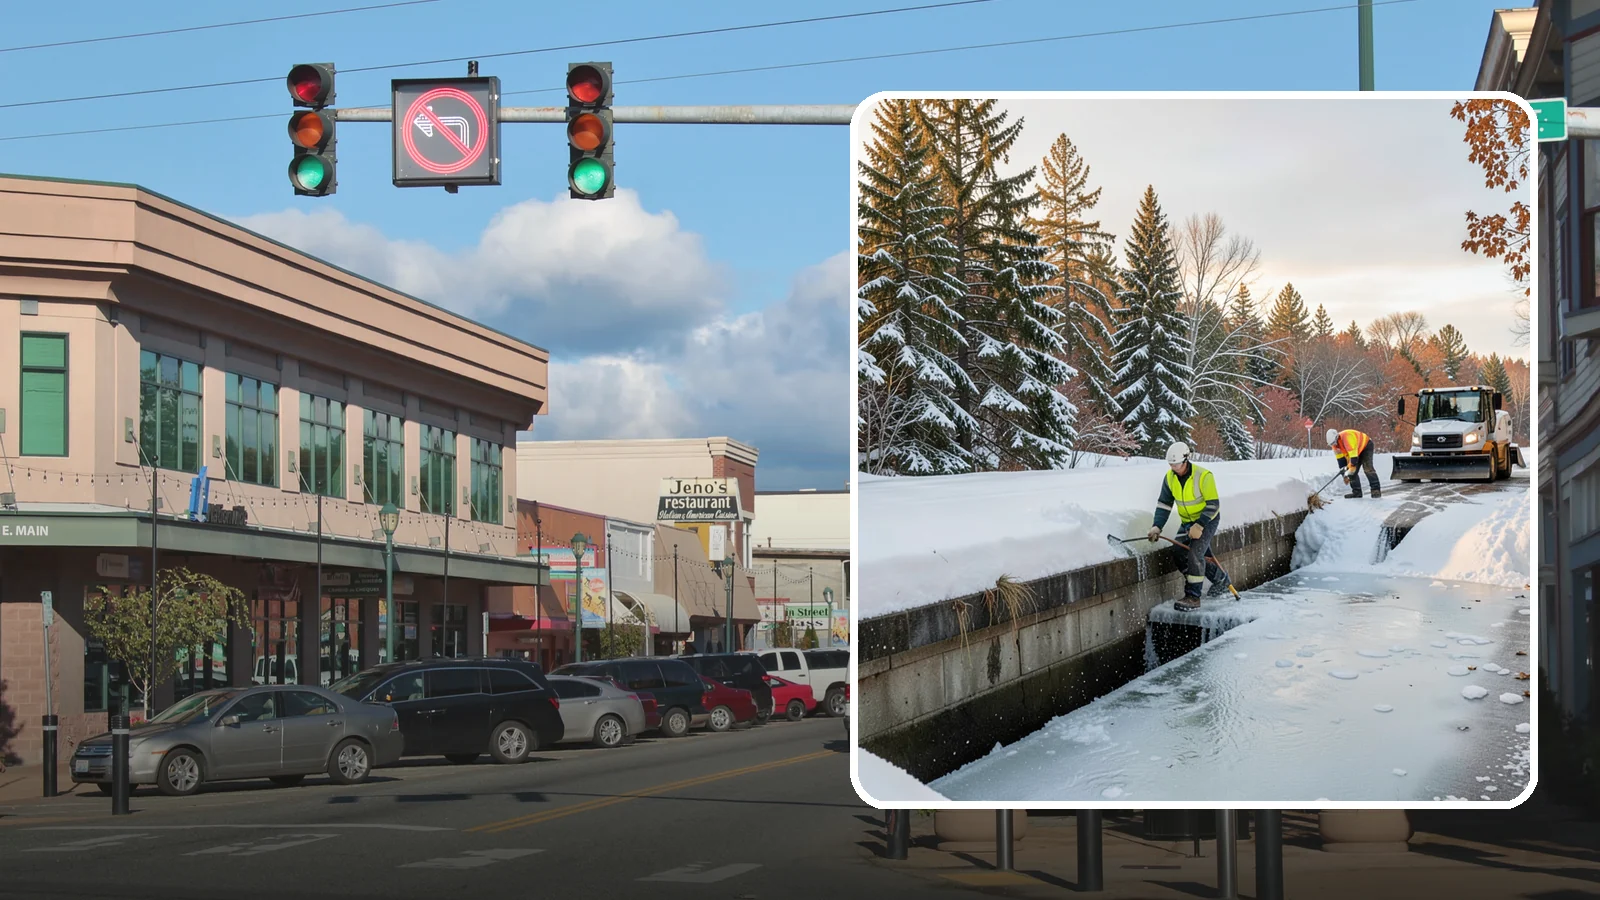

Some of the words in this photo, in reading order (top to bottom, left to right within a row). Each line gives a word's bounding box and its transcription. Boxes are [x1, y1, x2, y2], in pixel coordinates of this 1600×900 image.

[670, 480, 727, 494] Jeno's
[665, 496, 730, 508] restaurant
[658, 510, 682, 519] Italian
[686, 510, 714, 518] American
[715, 510, 737, 518] Cuisine
[2, 526, 12, 536] E.
[16, 526, 48, 536] MAIN
[798, 608, 828, 616] Street
